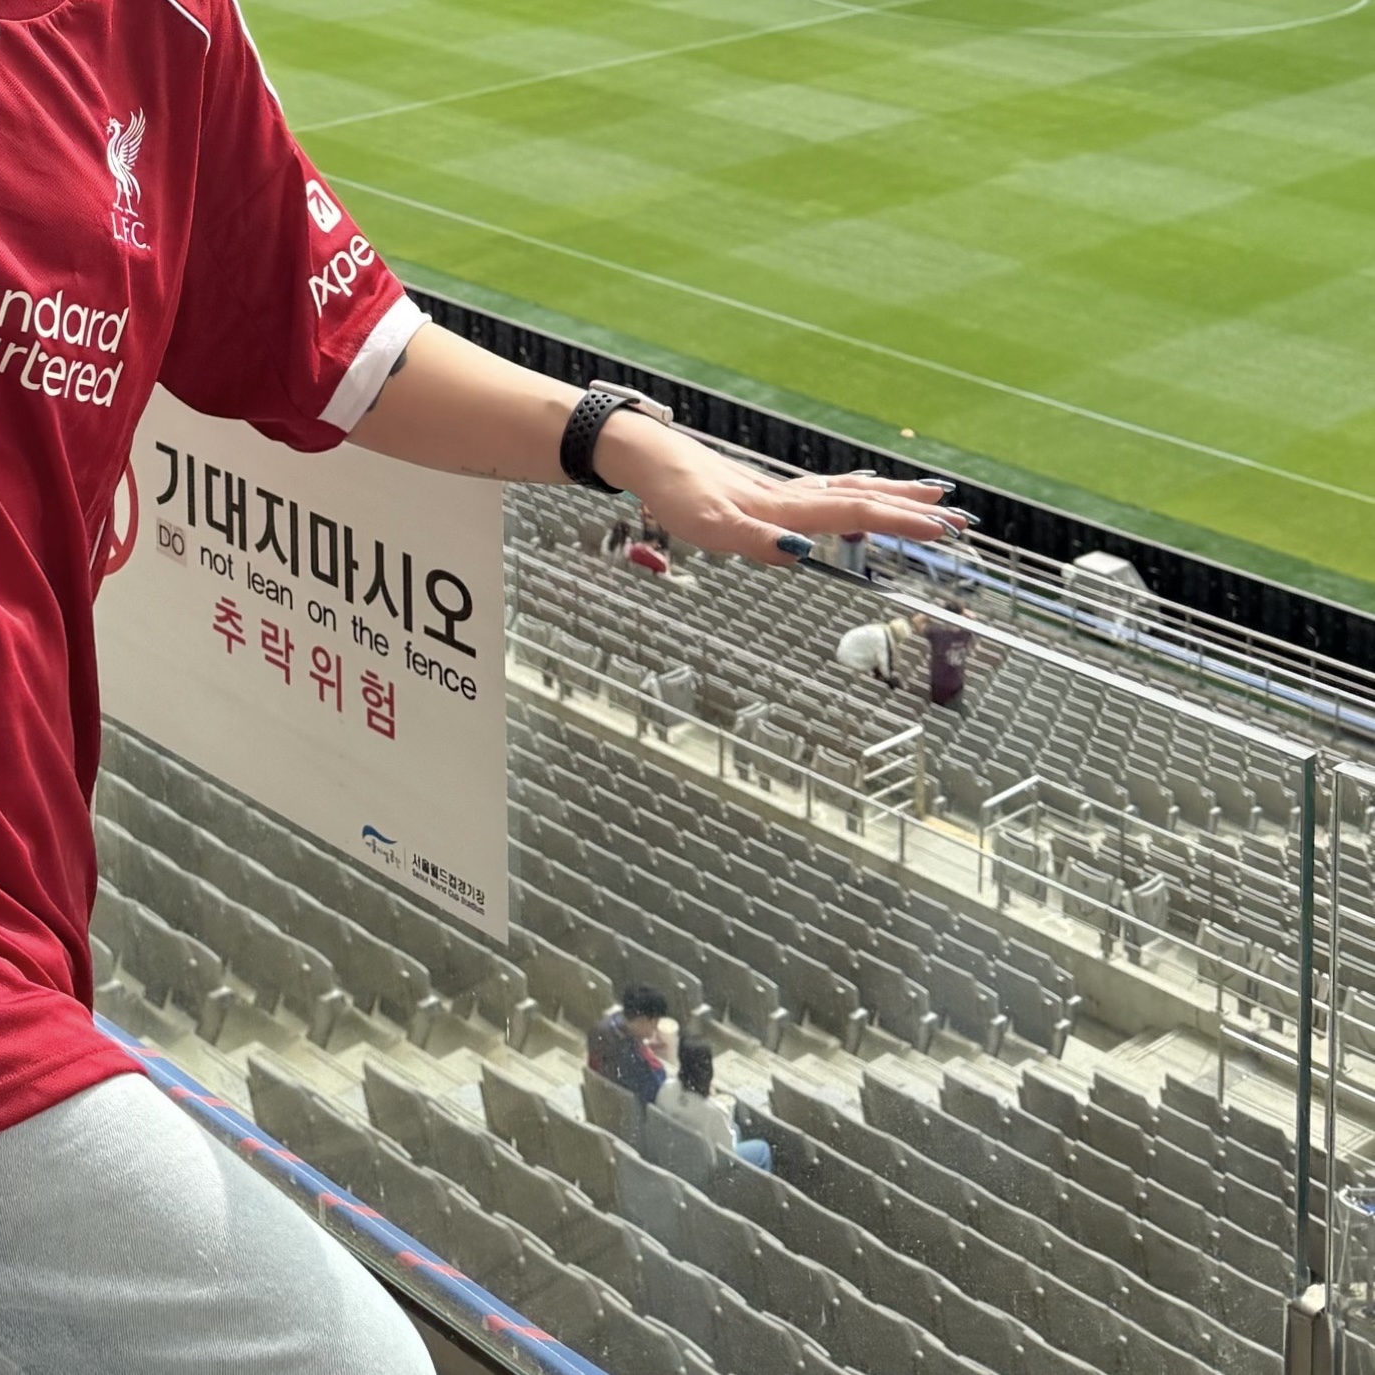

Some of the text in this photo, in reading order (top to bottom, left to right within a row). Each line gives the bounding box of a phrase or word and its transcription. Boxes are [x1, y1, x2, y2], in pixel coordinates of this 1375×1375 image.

[155, 440, 477, 660] 기대지마시오
[159, 524, 477, 701] DO not lean on the fence
